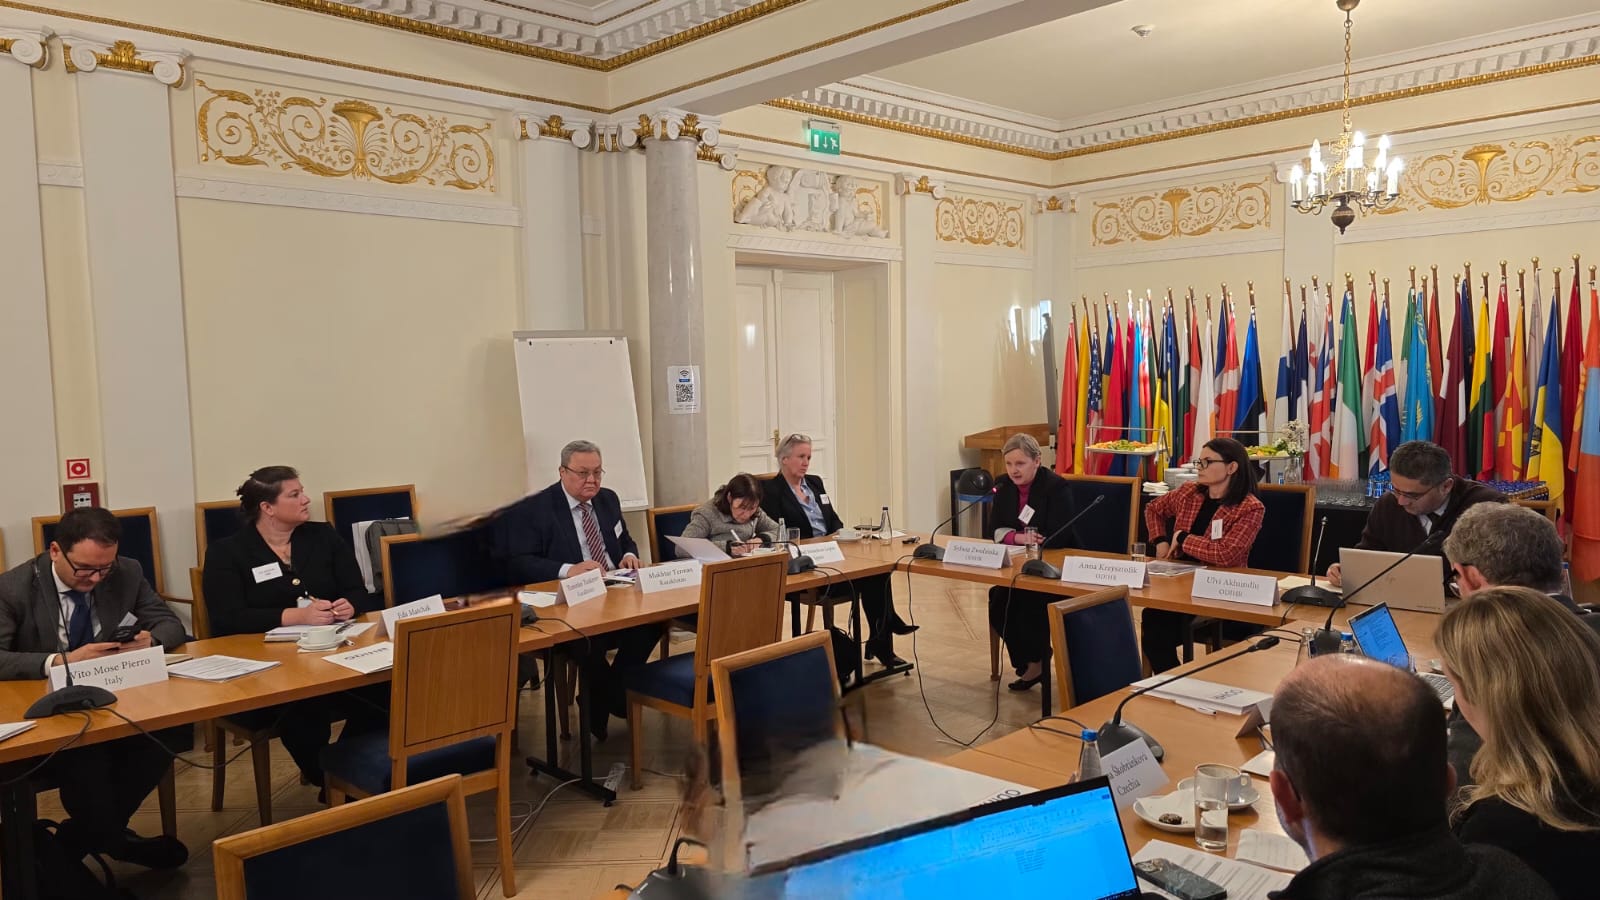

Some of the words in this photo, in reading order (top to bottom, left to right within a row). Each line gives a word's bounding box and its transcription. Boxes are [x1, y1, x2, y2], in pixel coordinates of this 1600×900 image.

[1079, 562, 1097, 570] Anna
[70, 670, 92, 681] Vito
[94, 664, 120, 676] Mose
[121, 658, 151, 670] Pierro
[104, 675, 124, 686] Italy
[1116, 778, 1142, 797] Czechia
